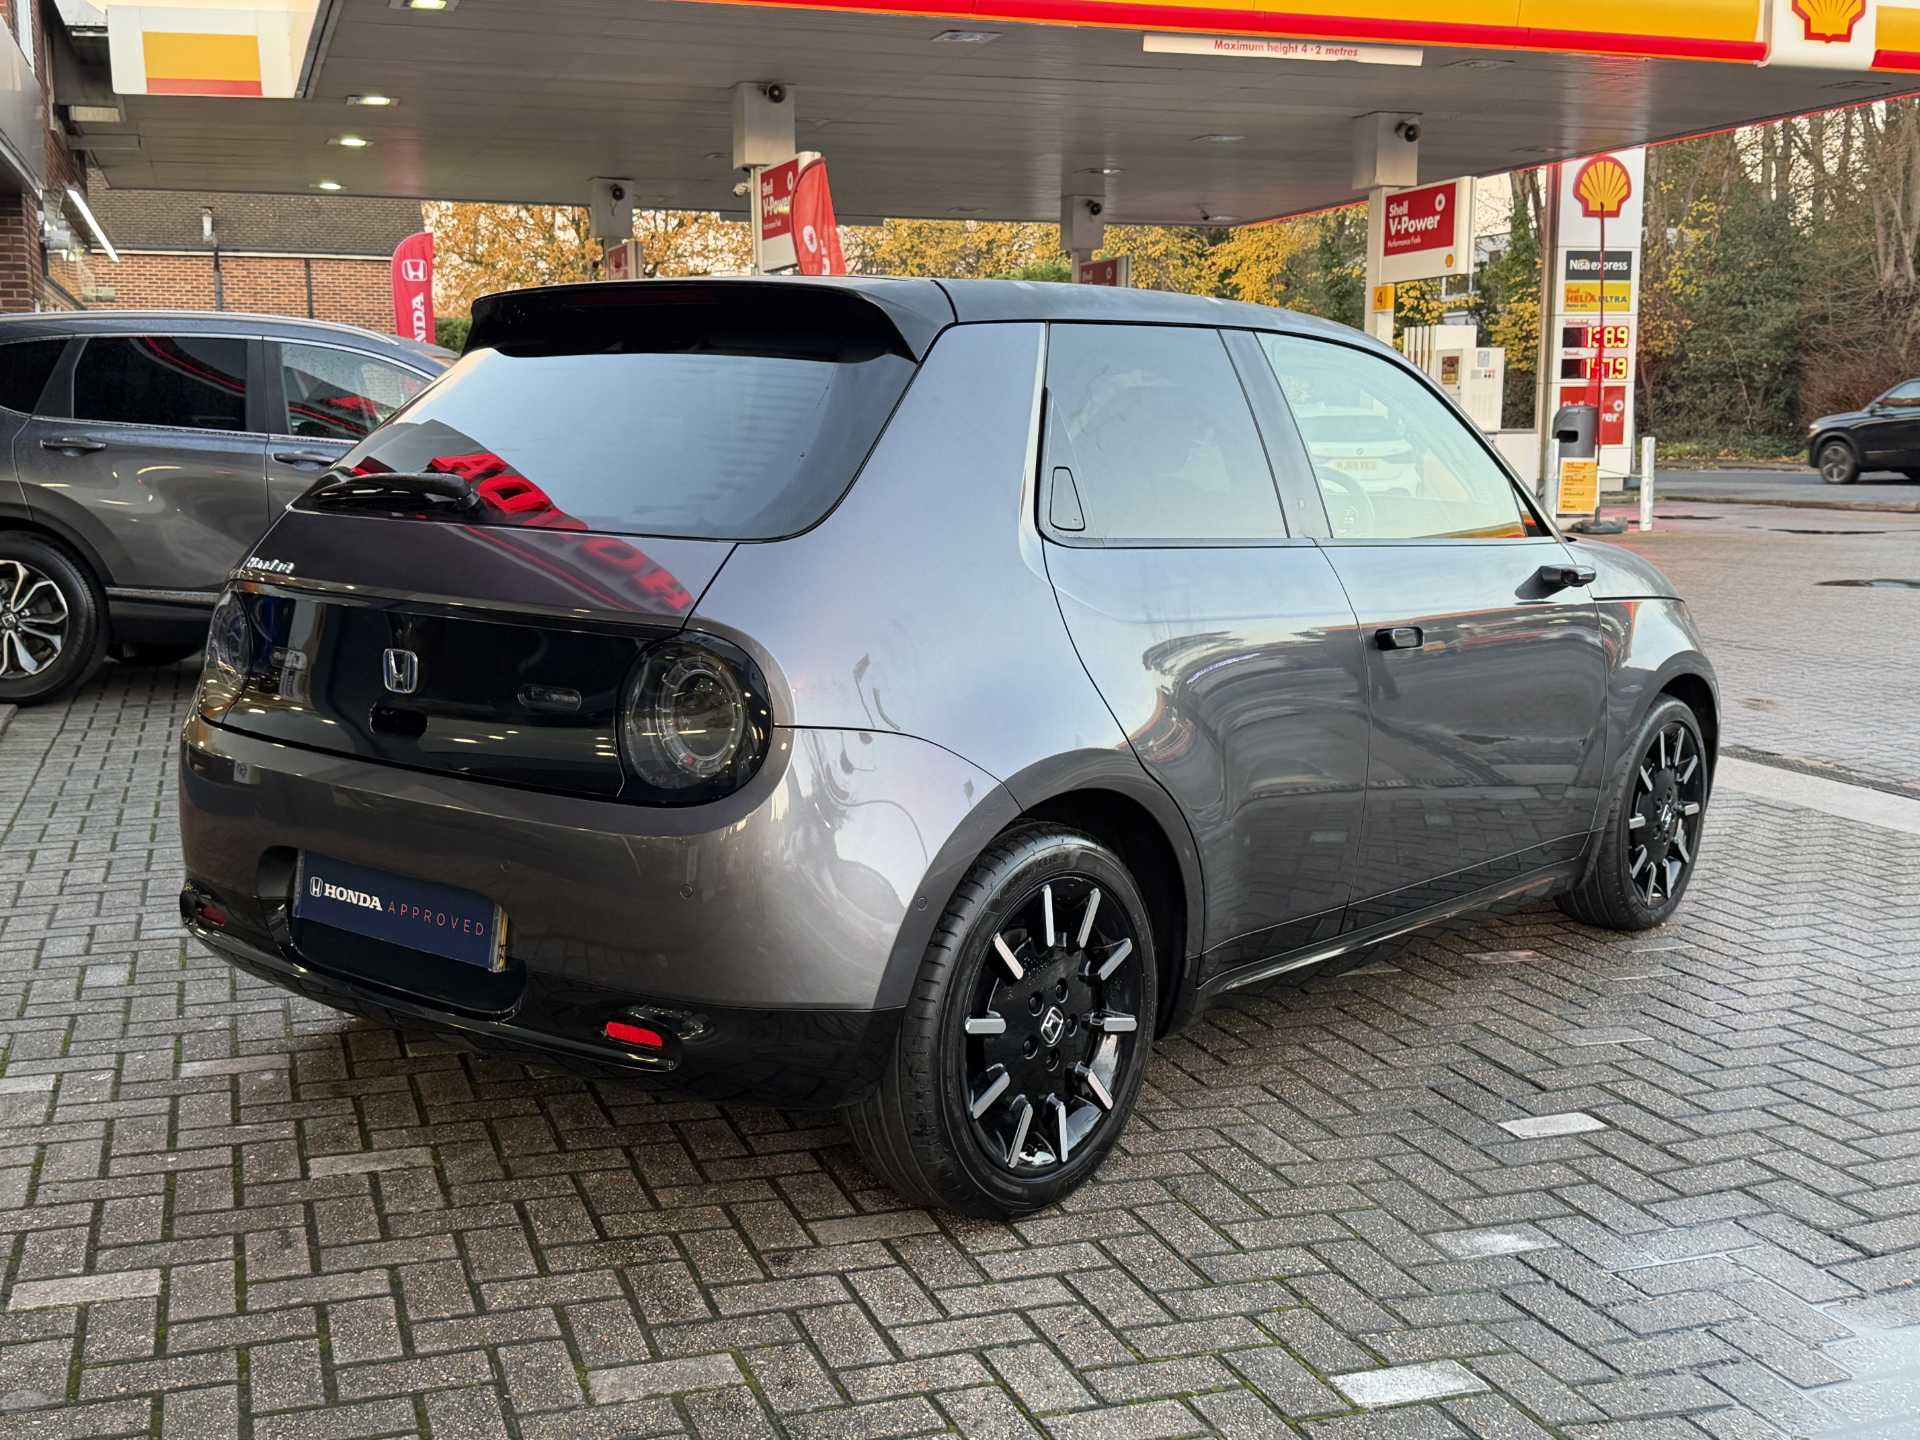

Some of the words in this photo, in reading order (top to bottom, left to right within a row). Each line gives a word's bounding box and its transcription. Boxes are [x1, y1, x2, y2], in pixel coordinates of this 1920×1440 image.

[1214, 40, 1265, 51] Maximum
[1267, 41, 1298, 55] height
[1325, 47, 1358, 57] metres
[1389, 200, 1408, 217] Shell
[1389, 215, 1440, 236] V-Power
[1567, 292, 1596, 304] HELIX
[324, 883, 383, 911] HONDA
[387, 901, 485, 936] APPROVED
